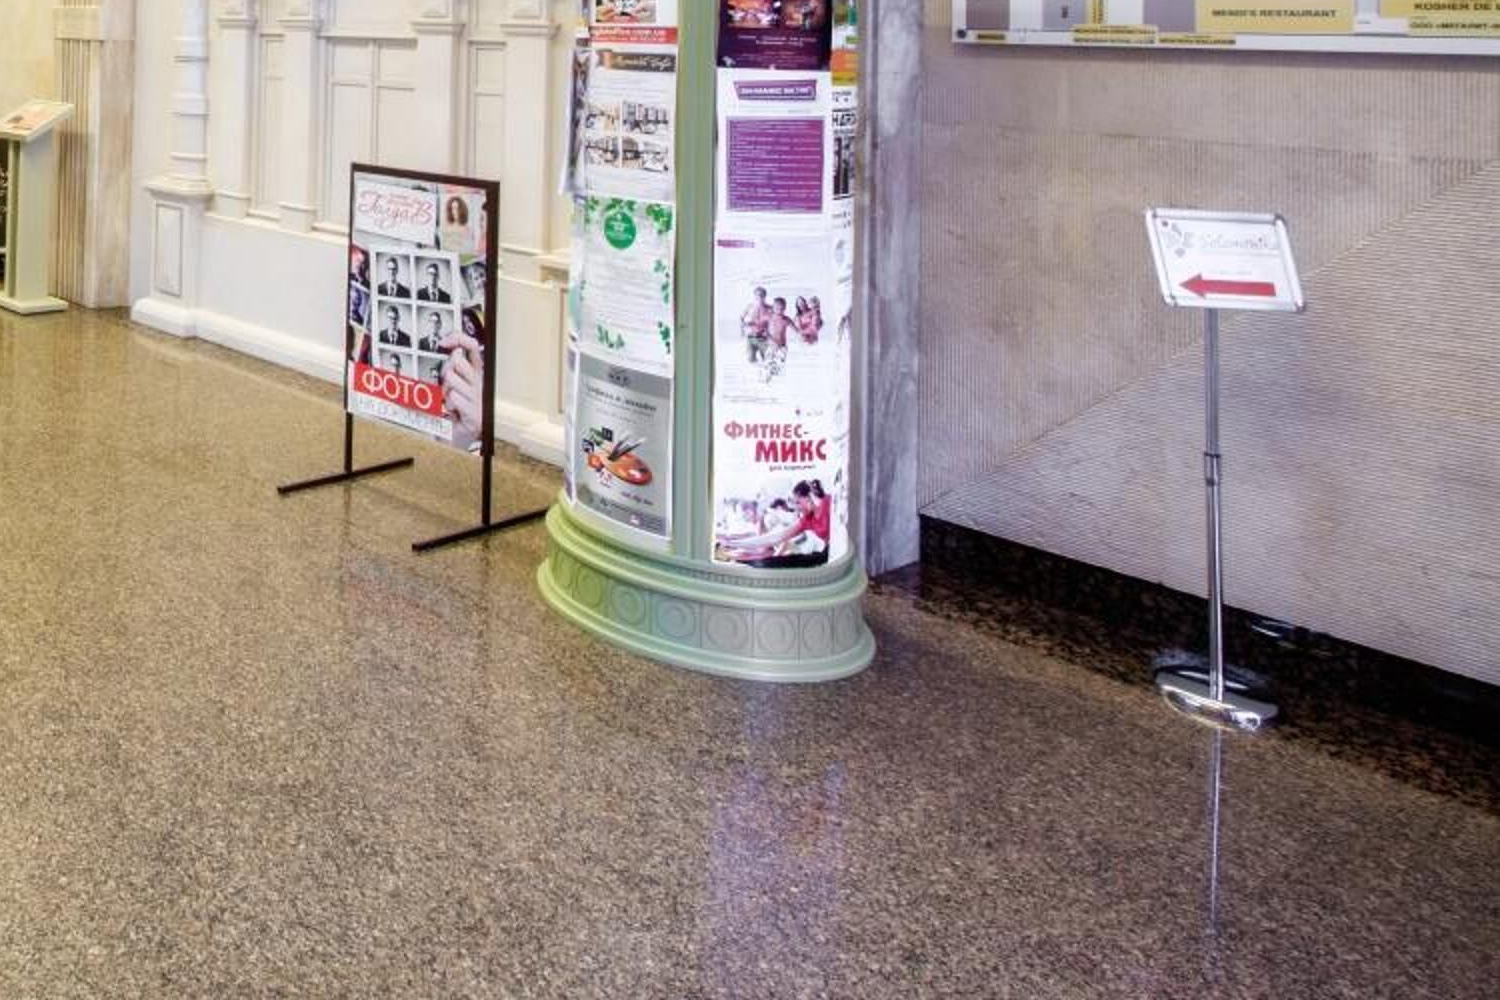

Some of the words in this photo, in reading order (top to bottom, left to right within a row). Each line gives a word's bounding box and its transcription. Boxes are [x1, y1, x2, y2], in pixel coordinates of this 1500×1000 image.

[1259, 9, 1337, 18] RESTAURANT
[1413, 1, 1470, 11] KOSHER
[362, 369, 433, 409] ФОТО
[723, 420, 809, 440] ФИТНЕС-
[755, 438, 827, 463] МИКС
